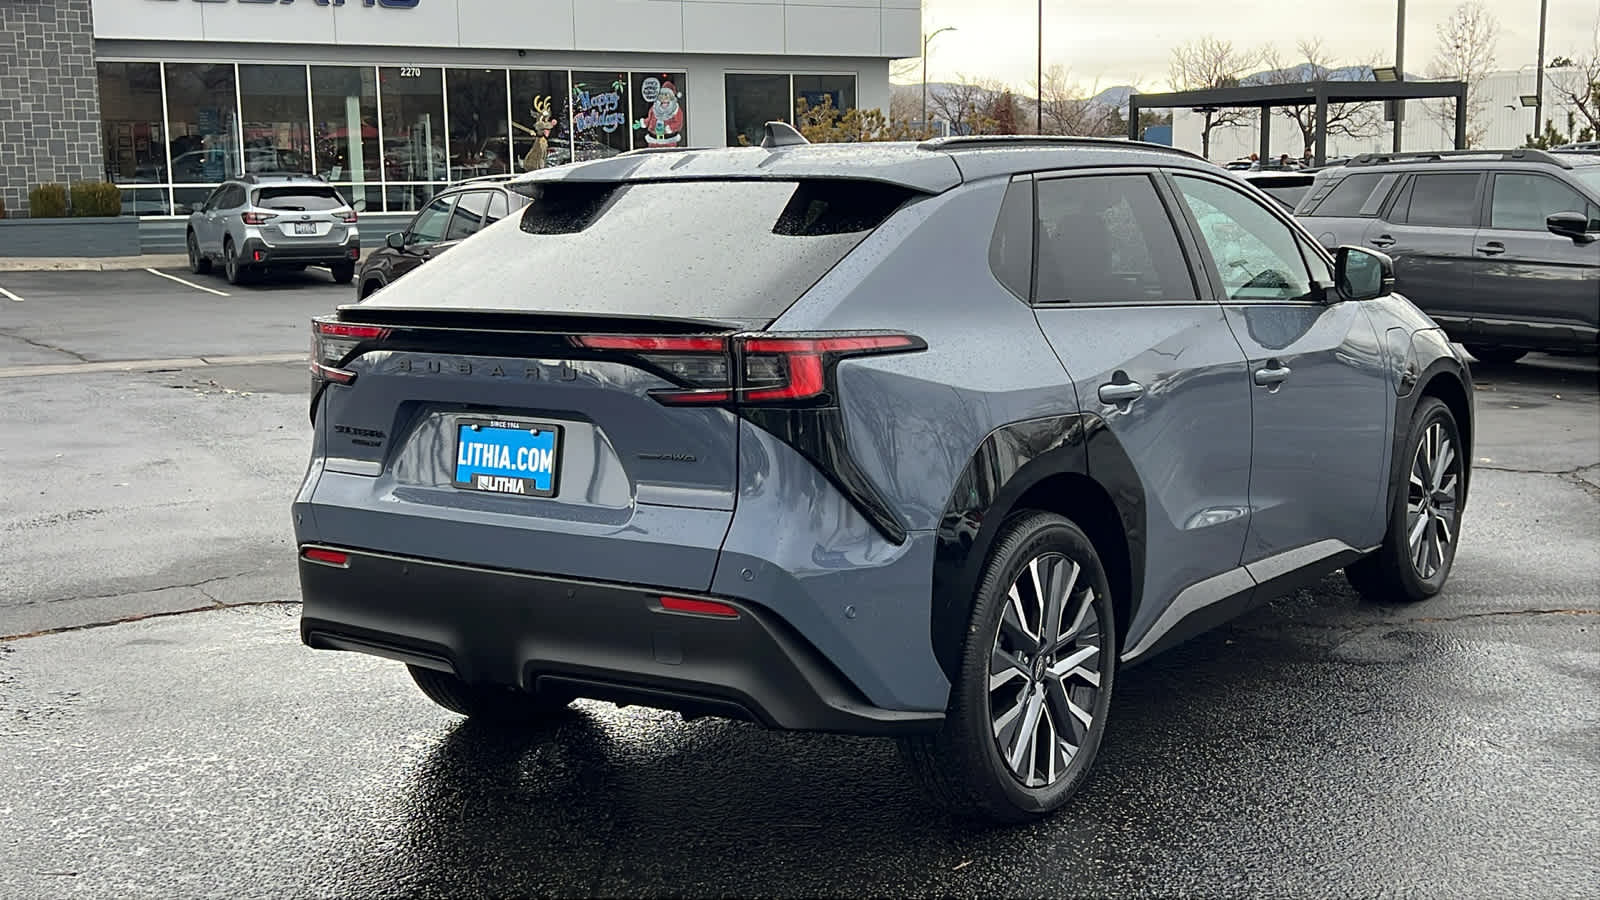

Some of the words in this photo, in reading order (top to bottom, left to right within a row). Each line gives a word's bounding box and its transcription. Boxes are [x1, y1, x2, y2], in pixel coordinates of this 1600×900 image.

[400, 67, 421, 77] 2270
[579, 90, 620, 112] Happy
[395, 358, 577, 382] SUBARU
[457, 441, 554, 475] LITHIA.COM
[488, 476, 525, 494] LITHIA
